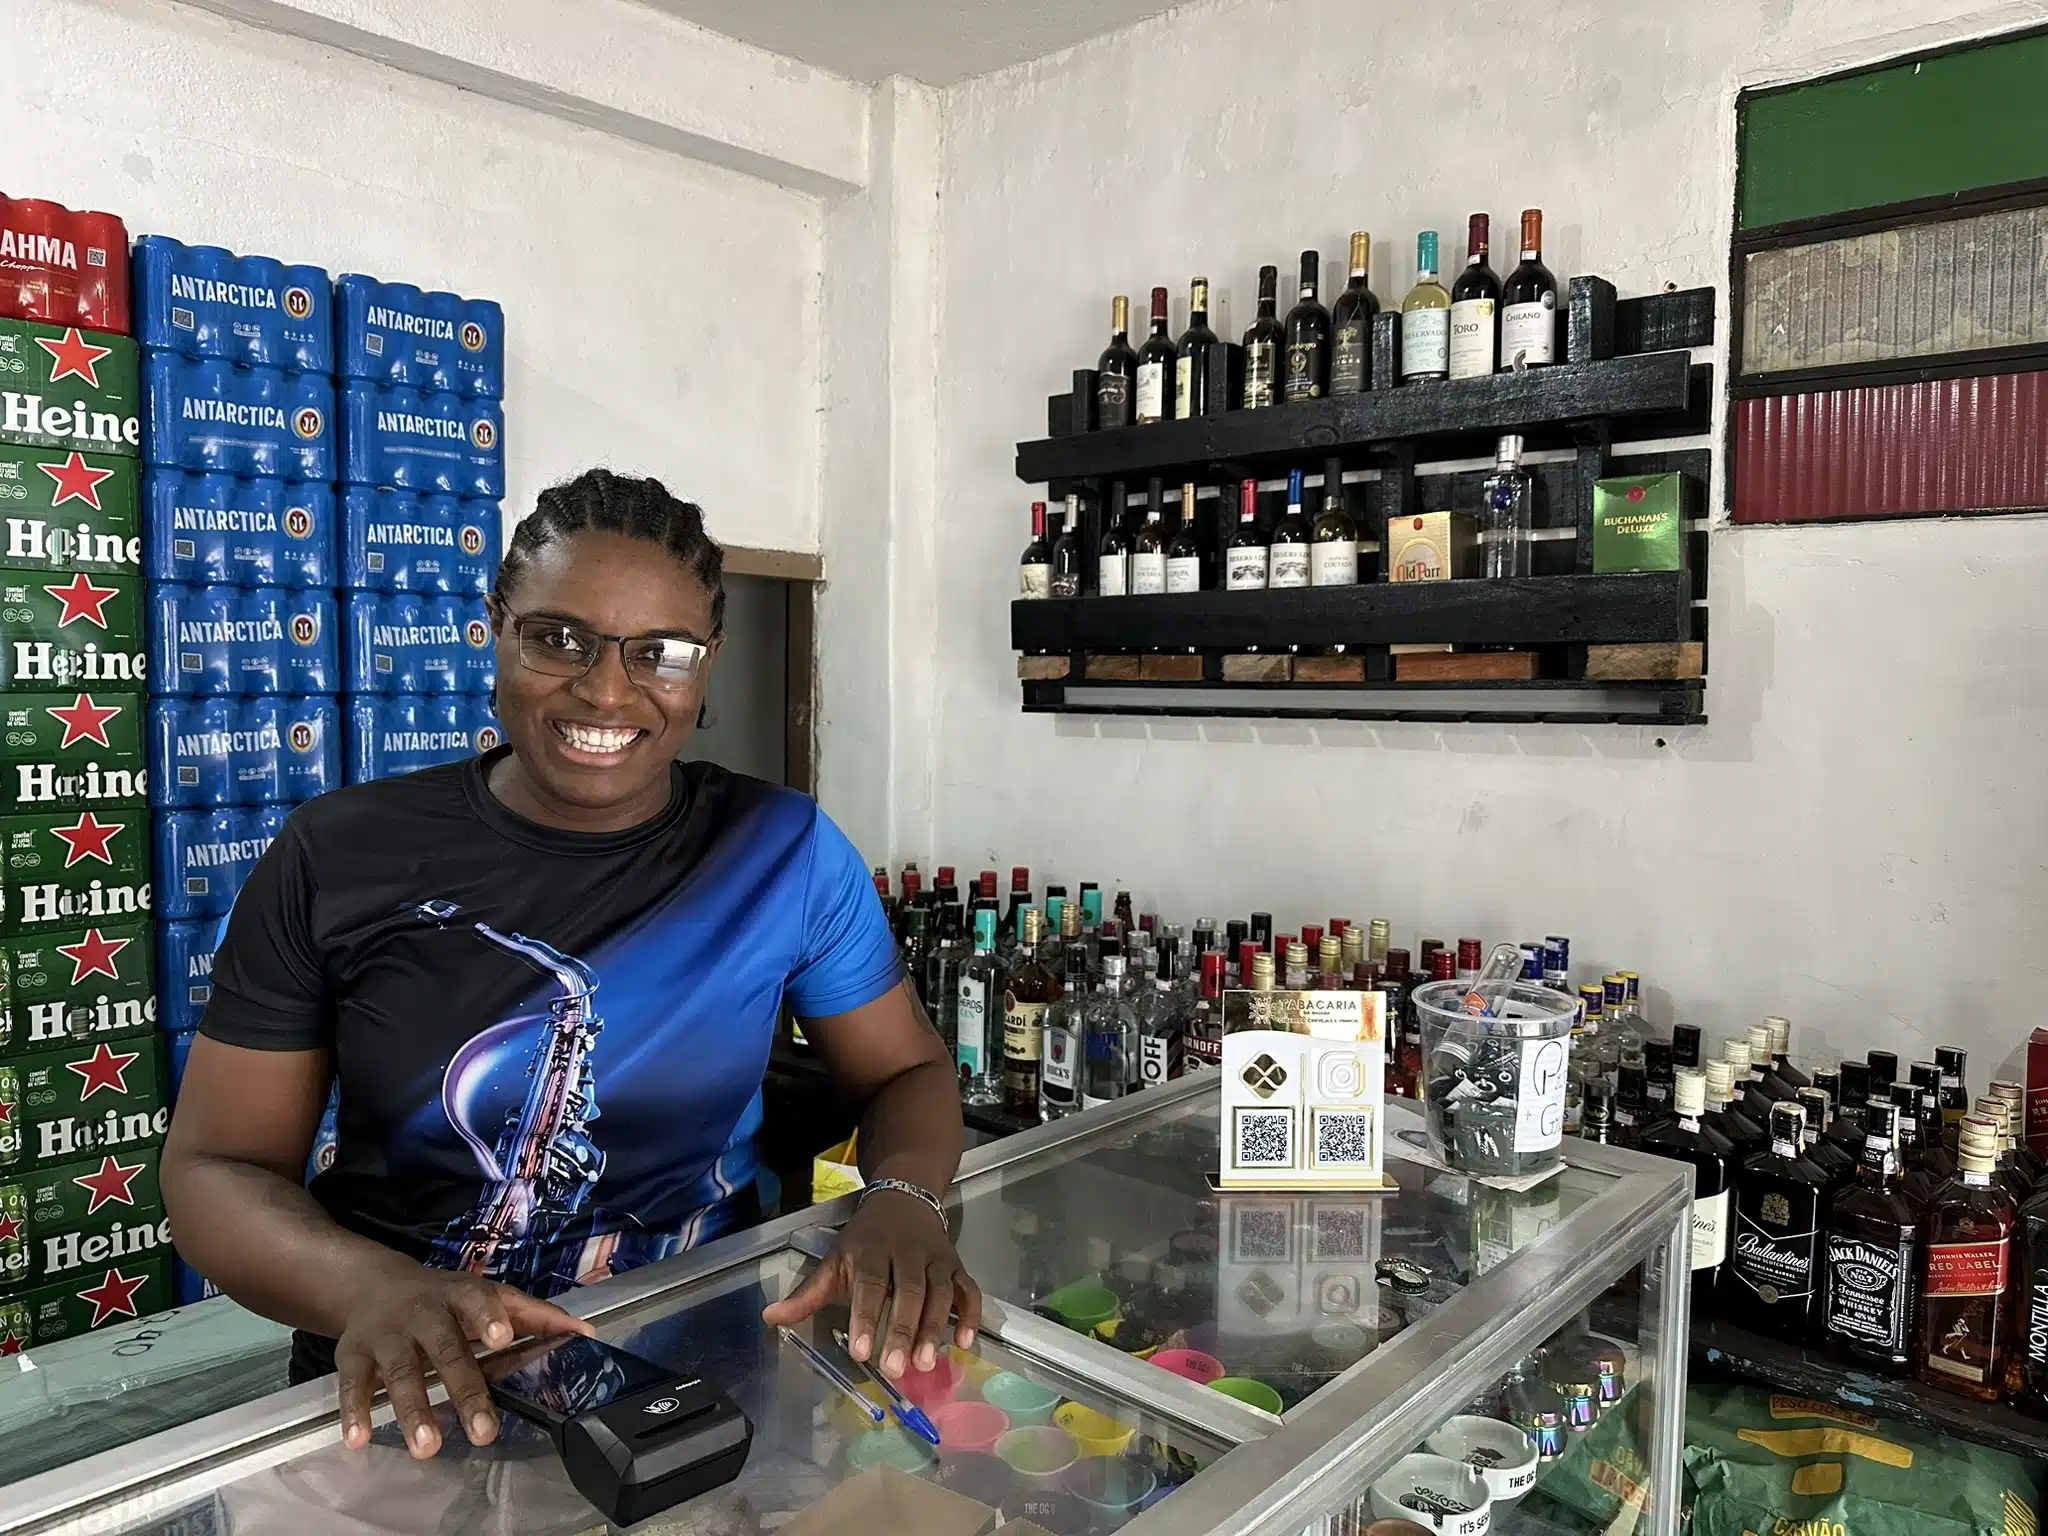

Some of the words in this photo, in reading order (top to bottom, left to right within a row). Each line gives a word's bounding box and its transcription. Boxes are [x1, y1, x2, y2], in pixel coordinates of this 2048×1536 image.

[171, 272, 277, 311] ANTARCTICA
[367, 305, 454, 341] ANTARCTICA
[1505, 311, 1541, 324] CHILANO
[1453, 323, 1479, 336] TORO
[2, 391, 140, 446] Heine
[183, 397, 287, 431] ANTARCTICA
[377, 411, 466, 441] ANTARCTICA
[173, 506, 278, 536] ANTARCTICA
[1604, 512, 1669, 526] BUCHANAN'S
[366, 523, 454, 547] ANTARCTICA
[1416, 562, 1441, 581] Parr
[180, 620, 283, 646] ANTARCTICA
[373, 624, 460, 647] ANTARCTICA
[177, 728, 282, 757] ANTARCTICA
[384, 731, 469, 752] ANTARCTICA
[1279, 999, 1357, 1011] TABACARIA
[43, 1216, 173, 1274] Heine
[1737, 1232, 1810, 1269] Ballantine's
[1932, 1251, 1964, 1262] JOHNNIE
[1785, 1265, 1807, 1275] WHISKY
[1828, 1245, 1855, 1262] JACK
[1855, 1245, 1900, 1280] DANIEL'S
[1928, 1262, 1954, 1272] RED
[1957, 1260, 2001, 1271] LABEL
[1838, 1284, 1885, 1305] Tennessee
[1838, 1298, 1884, 1317] WHISKEY
[2028, 1285, 2048, 1364] MONTILLA
[1509, 1477, 1525, 1489] THE
[1526, 1471, 1535, 1486] OG
[1459, 1519, 1475, 1535] IT'S
